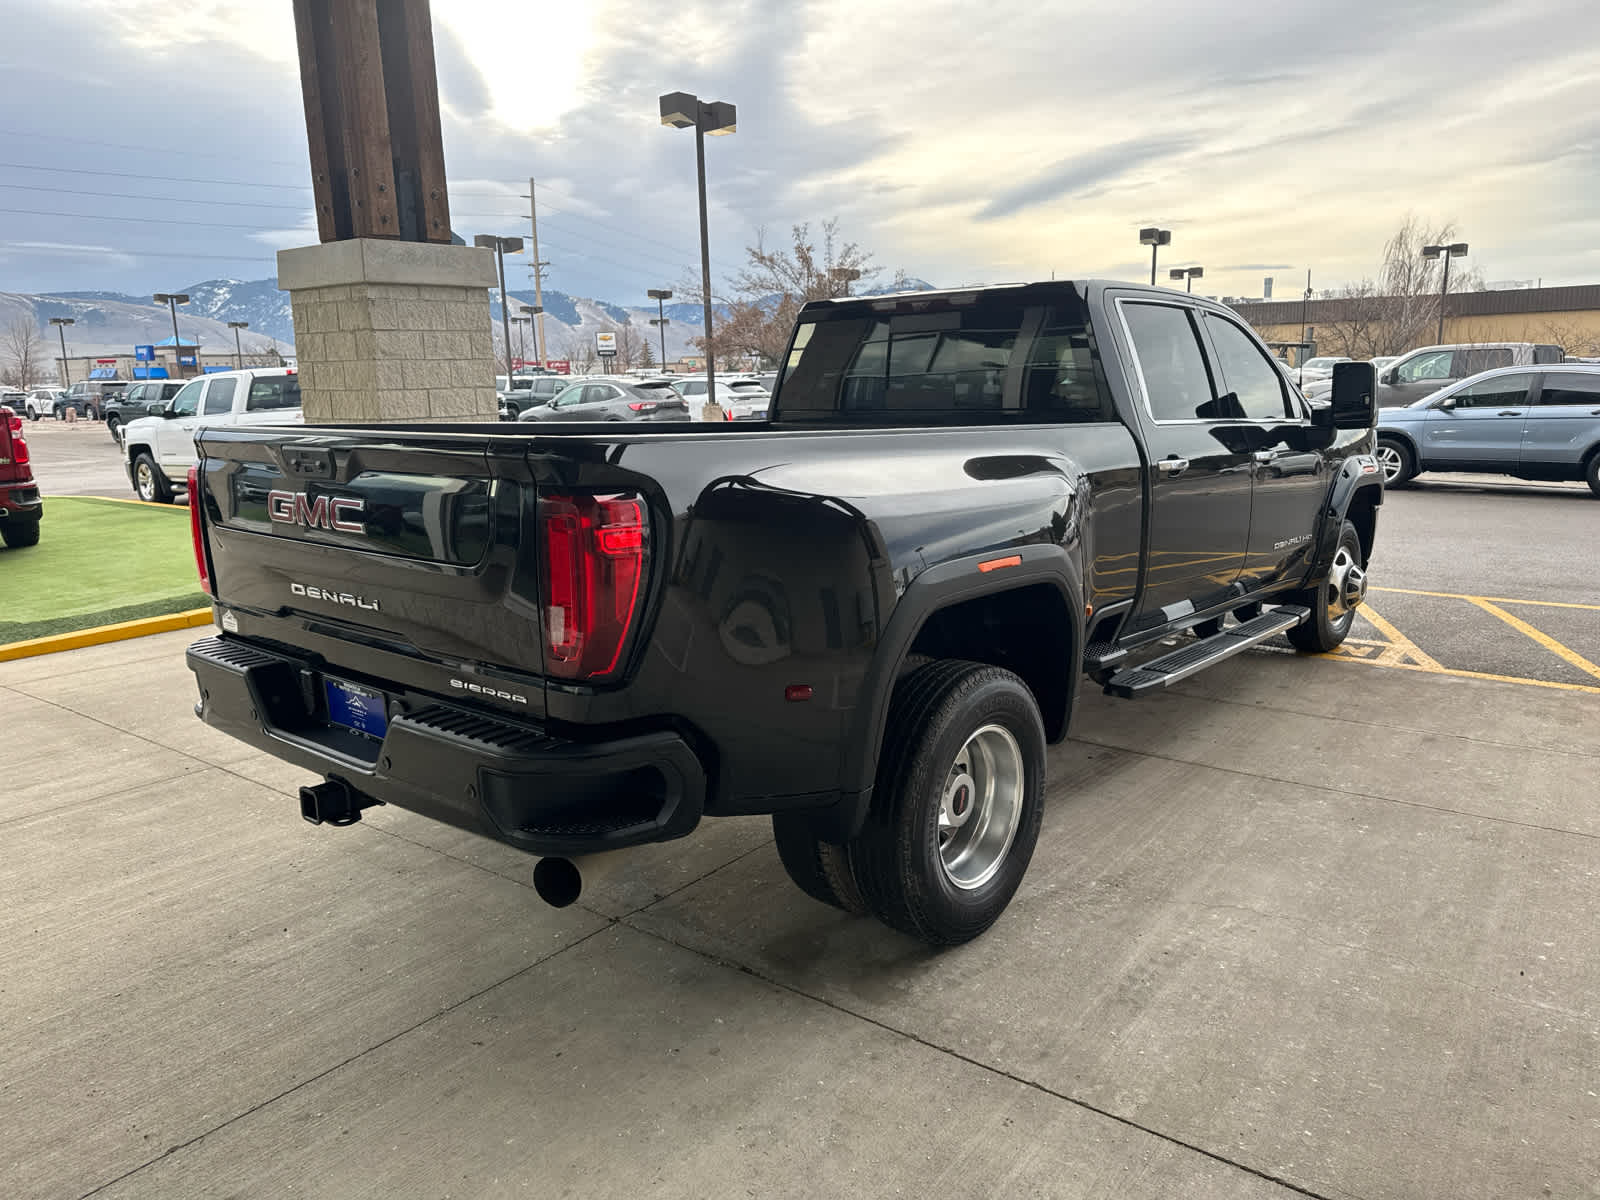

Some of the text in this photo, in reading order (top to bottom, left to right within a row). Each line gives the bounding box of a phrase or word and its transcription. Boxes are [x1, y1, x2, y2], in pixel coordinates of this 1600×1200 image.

[268, 490, 366, 534] GMC
[291, 583, 380, 611] DENALI
[449, 679, 527, 704] SIERRA
